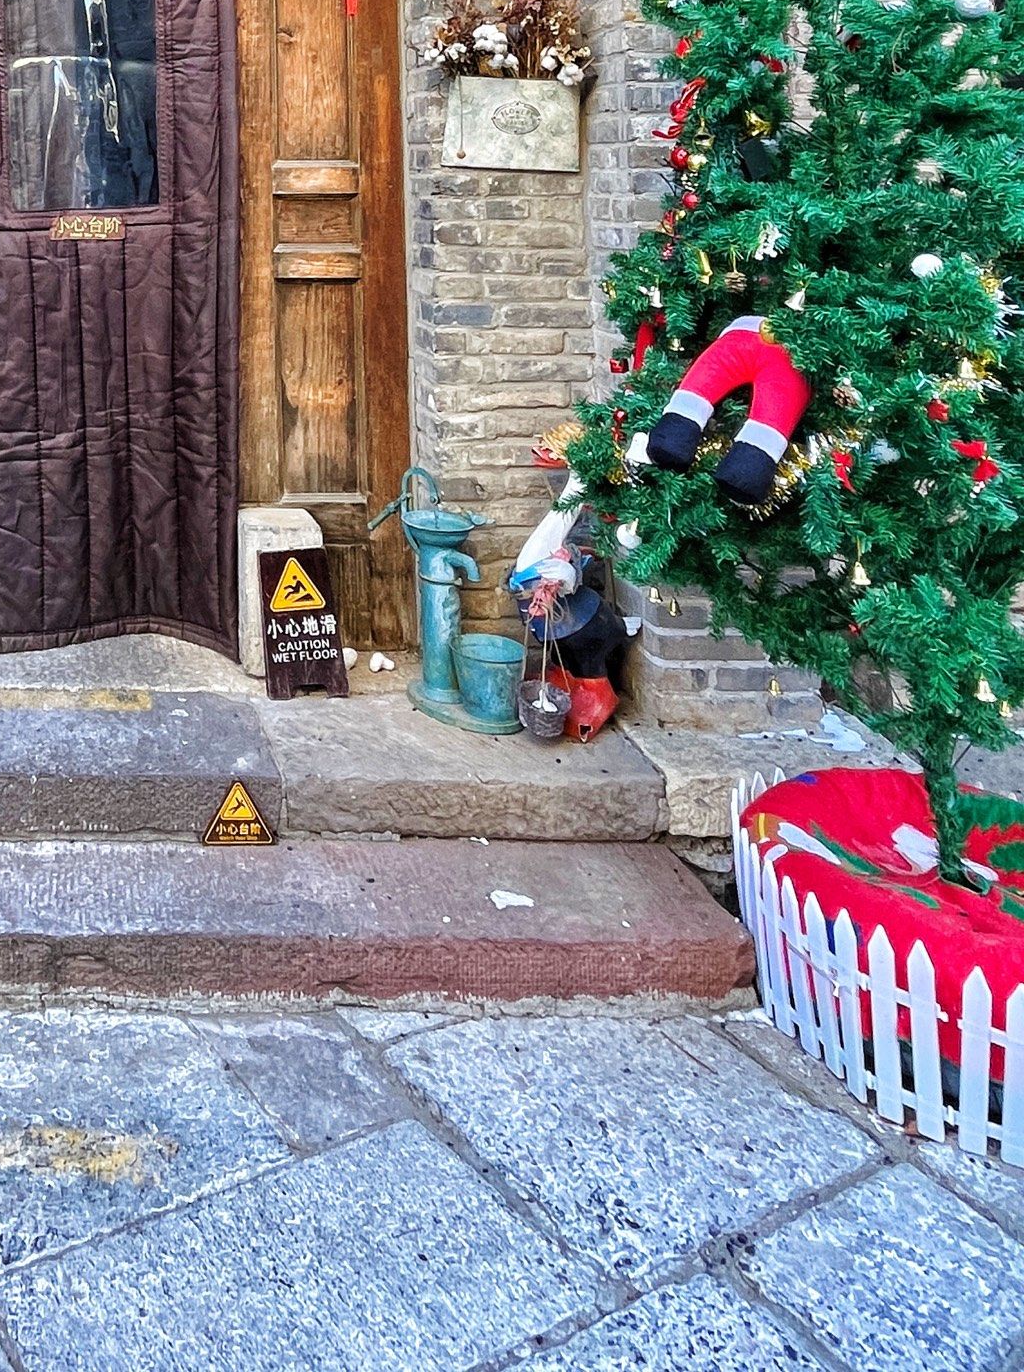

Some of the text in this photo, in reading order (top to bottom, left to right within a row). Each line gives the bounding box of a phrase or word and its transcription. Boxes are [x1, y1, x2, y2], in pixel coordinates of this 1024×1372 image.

[57, 216, 122, 234] 小心台阶
[267, 614, 337, 639] 小心地滑
[278, 638, 330, 653] CAUTION
[272, 649, 338, 663] WET FLOOR
[216, 823, 261, 835] 小心台阶
